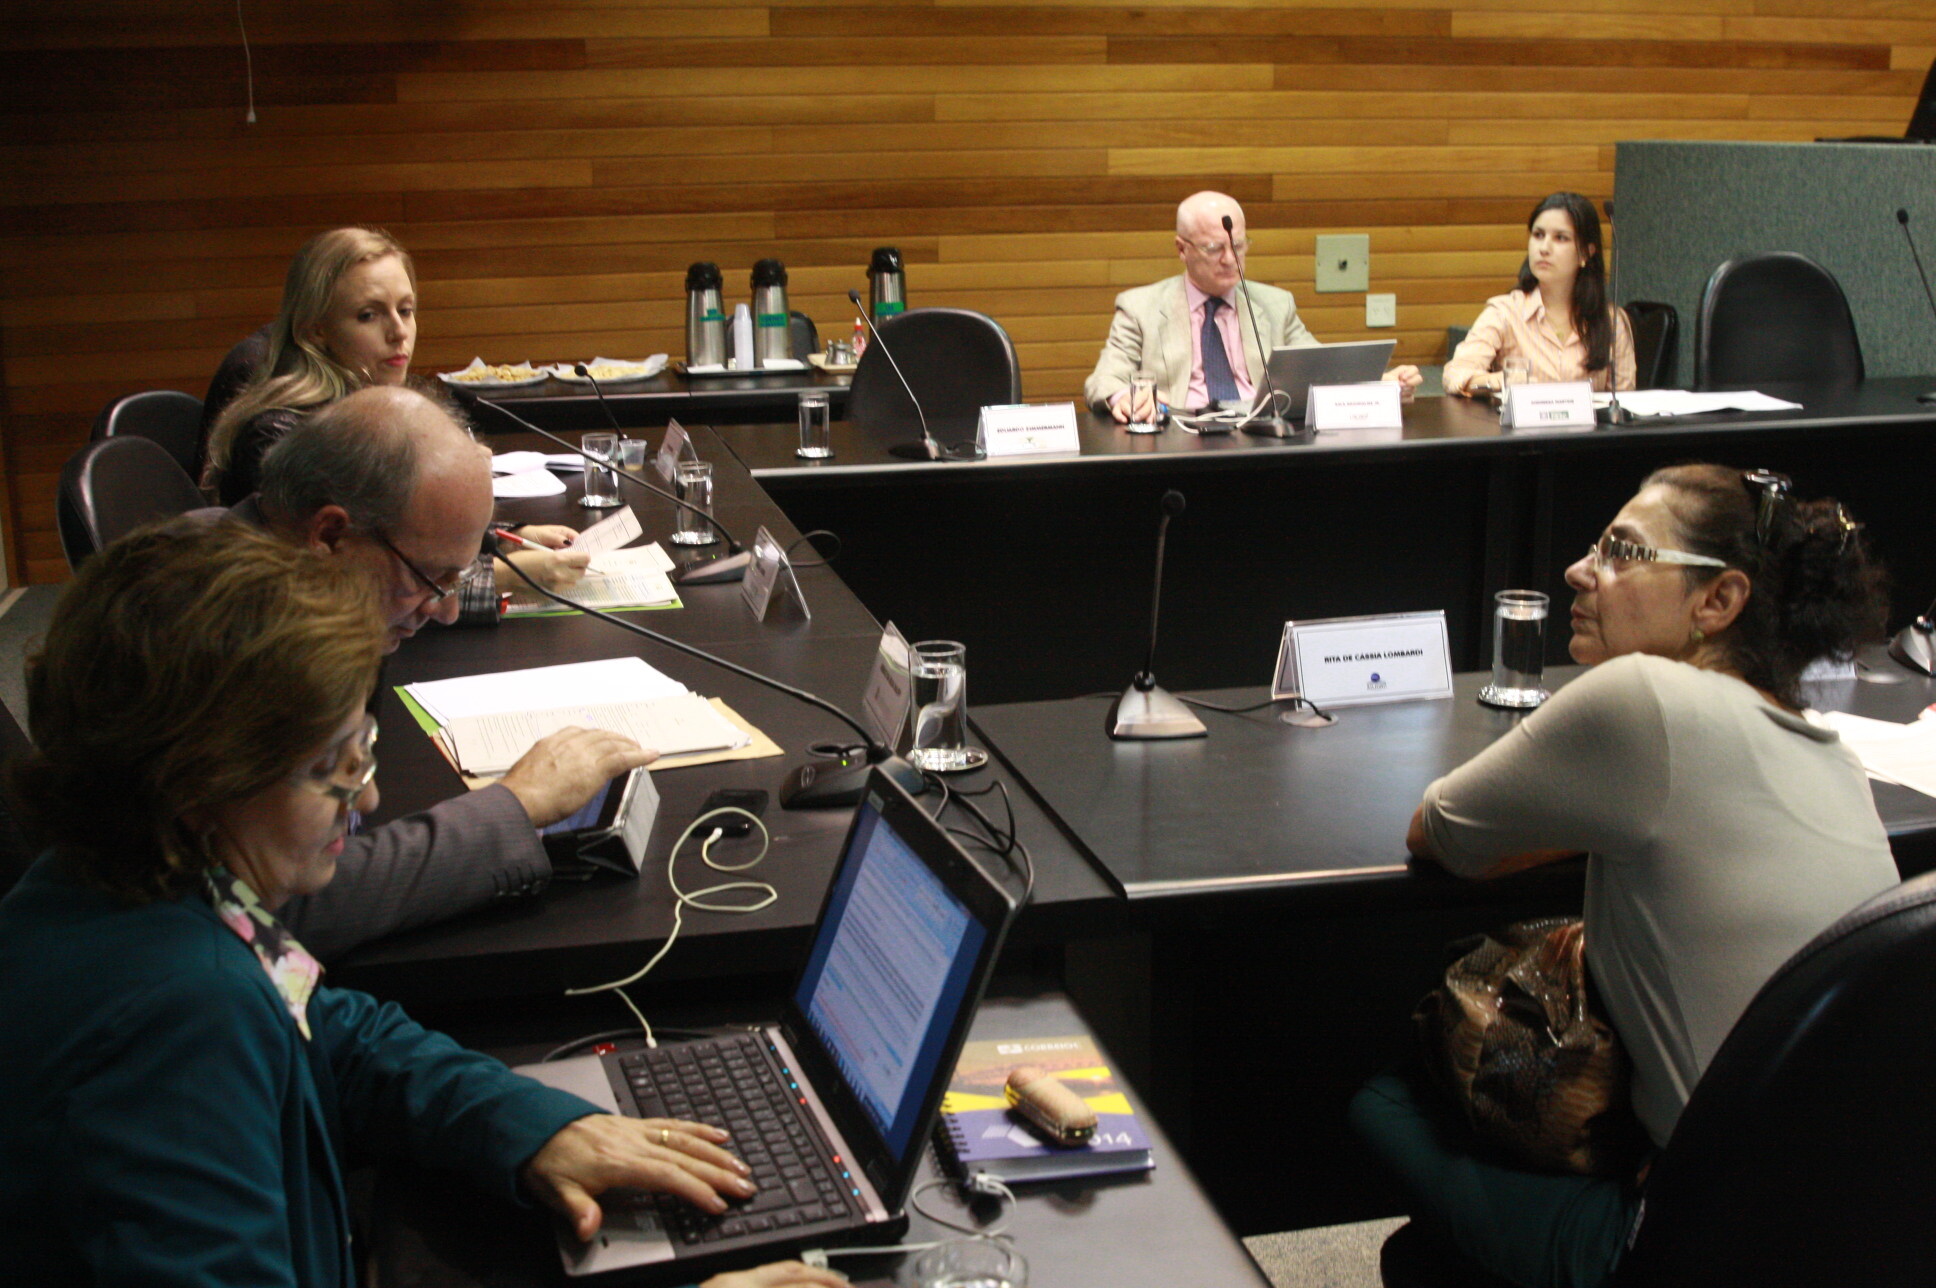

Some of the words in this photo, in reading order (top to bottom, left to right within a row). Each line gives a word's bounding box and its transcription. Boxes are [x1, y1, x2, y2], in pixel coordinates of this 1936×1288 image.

[1324, 655, 1341, 664] RITA
[1343, 654, 1353, 662] DE
[1355, 652, 1382, 661] CASSIA
[1383, 649, 1424, 659] LOMBARDI
[1088, 1131, 1131, 1146] 014
